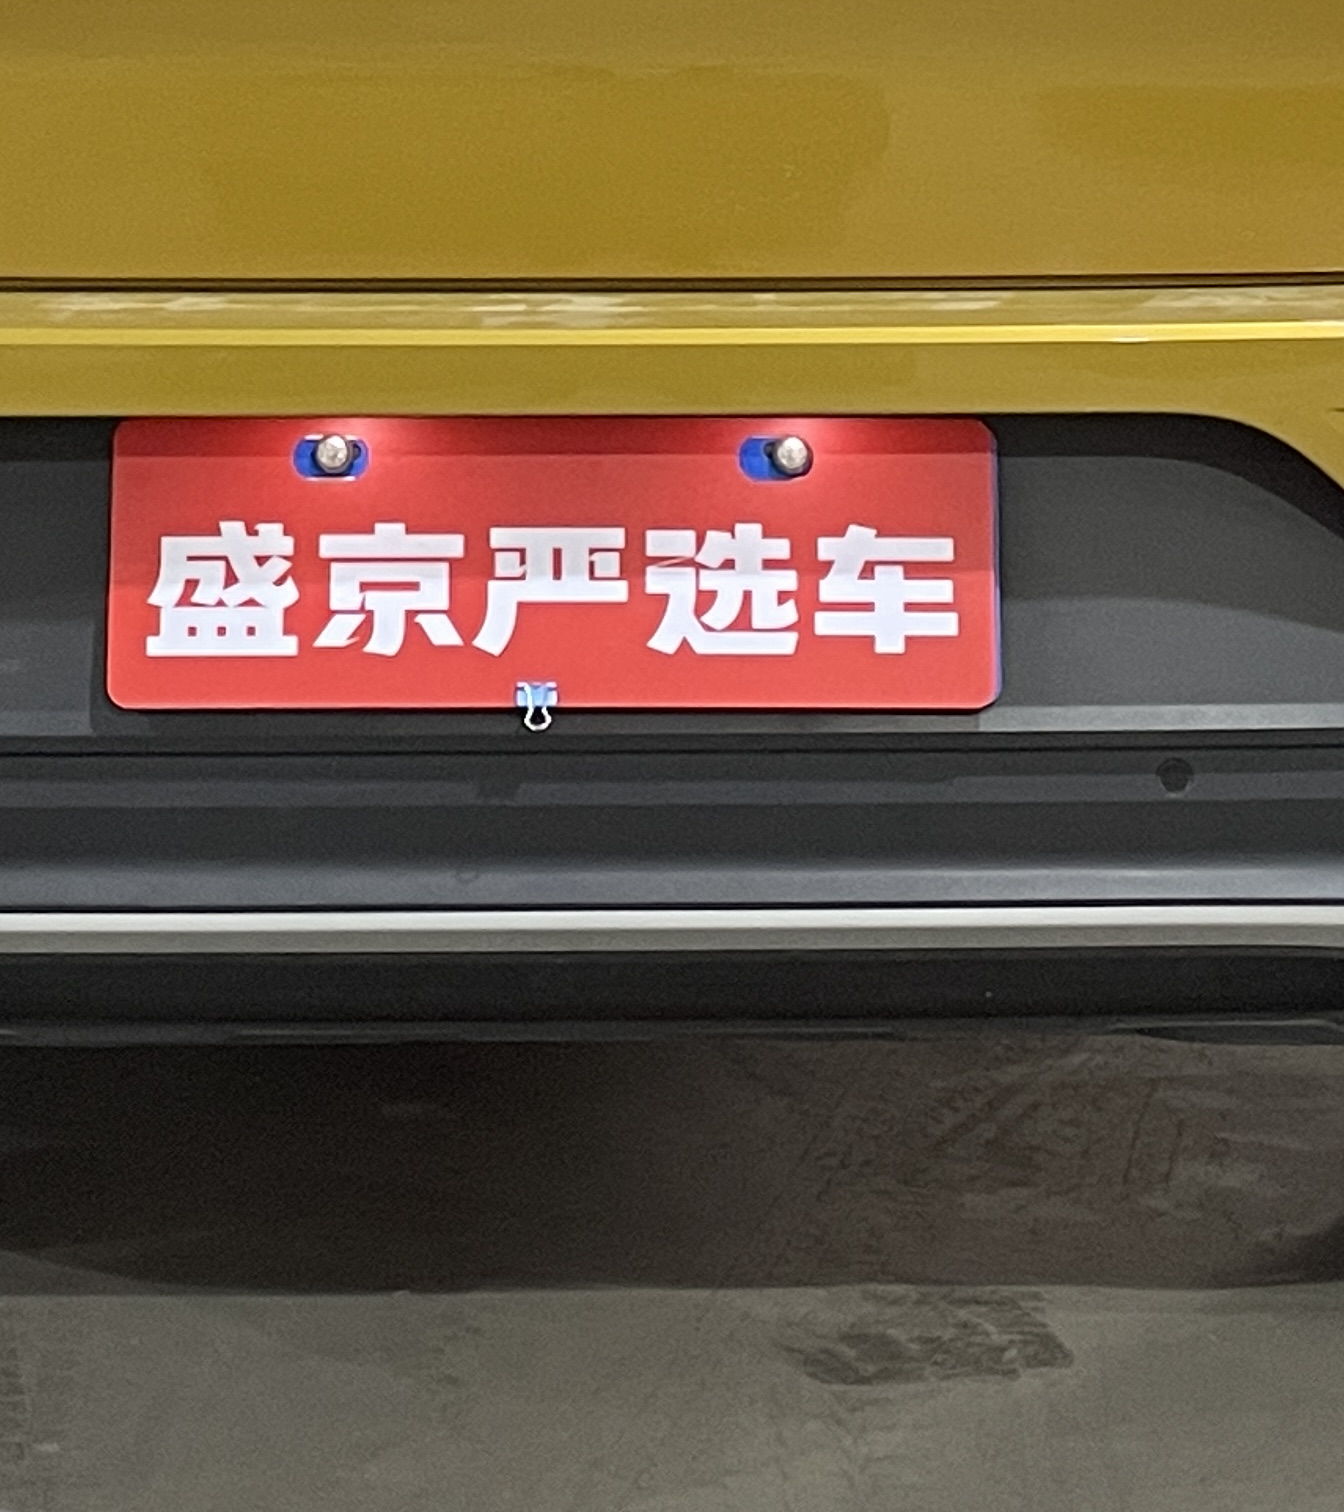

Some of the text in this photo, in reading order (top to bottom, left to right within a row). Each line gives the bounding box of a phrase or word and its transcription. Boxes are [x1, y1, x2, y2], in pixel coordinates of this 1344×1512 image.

[145, 521, 960, 657] 盛京严选车
